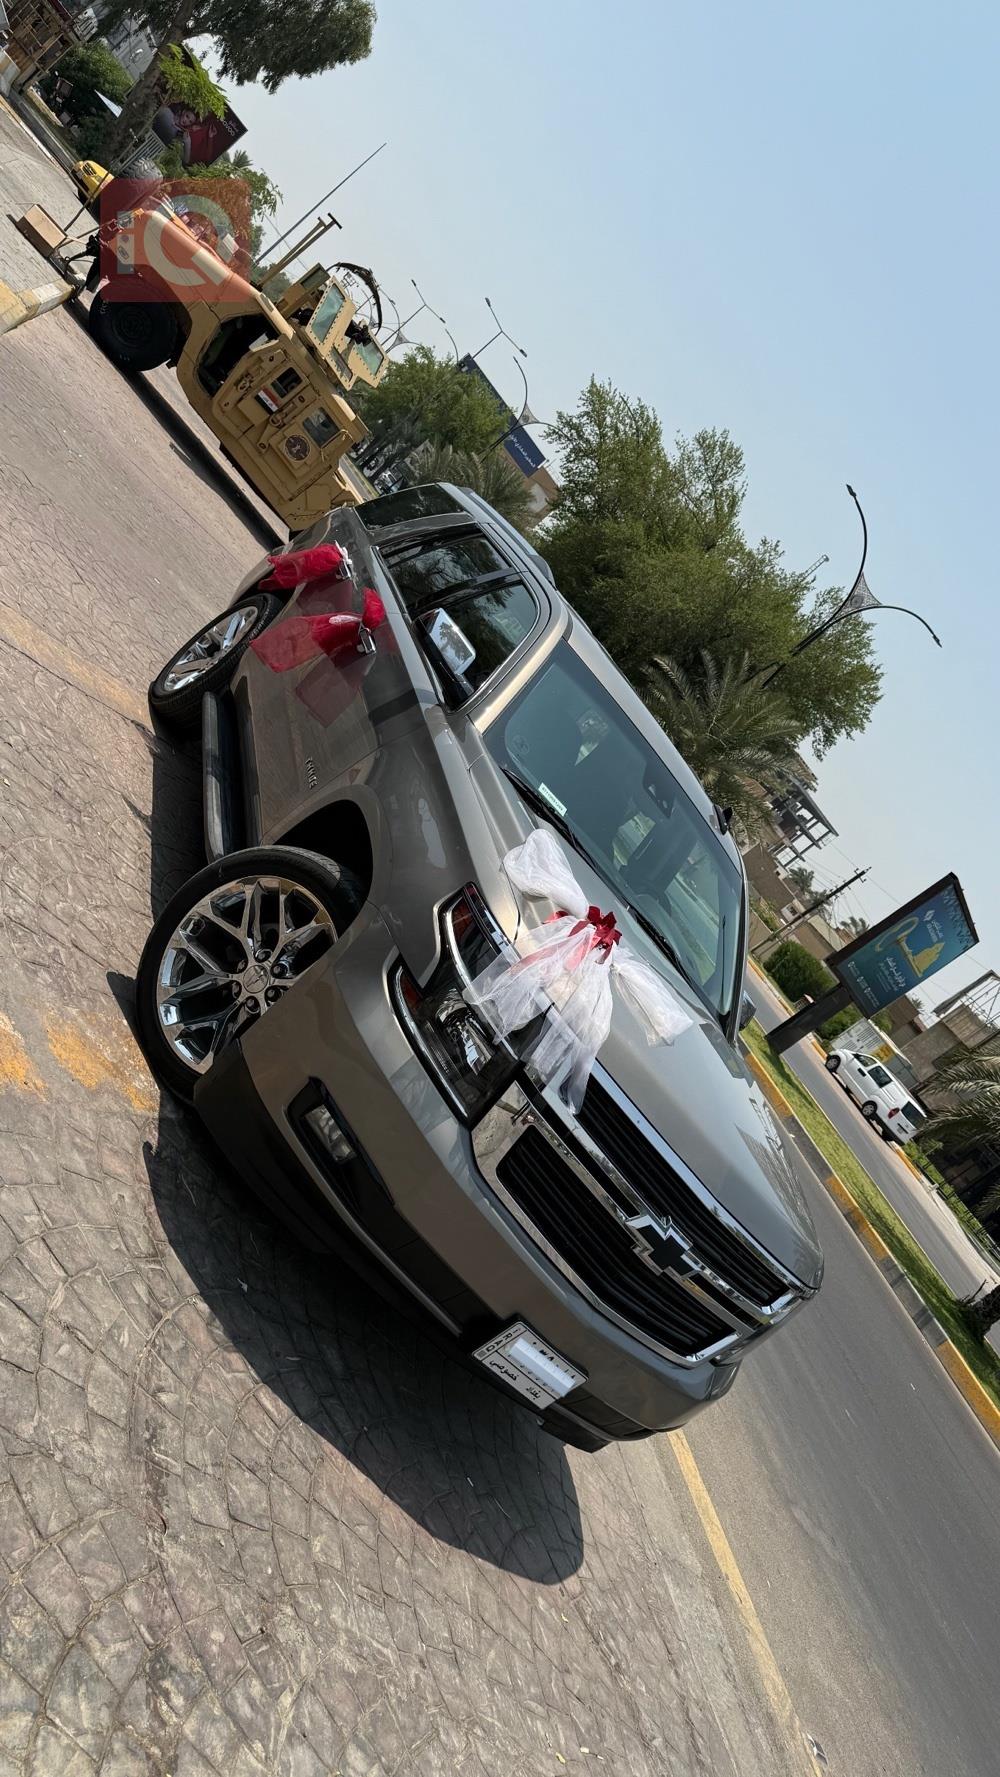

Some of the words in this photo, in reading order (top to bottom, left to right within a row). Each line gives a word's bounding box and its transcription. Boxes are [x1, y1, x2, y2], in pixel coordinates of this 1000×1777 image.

[486, 1329, 519, 1353] IRAQ
[489, 1360, 520, 1381] خصوصي
[526, 1386, 541, 1401] بغداد
